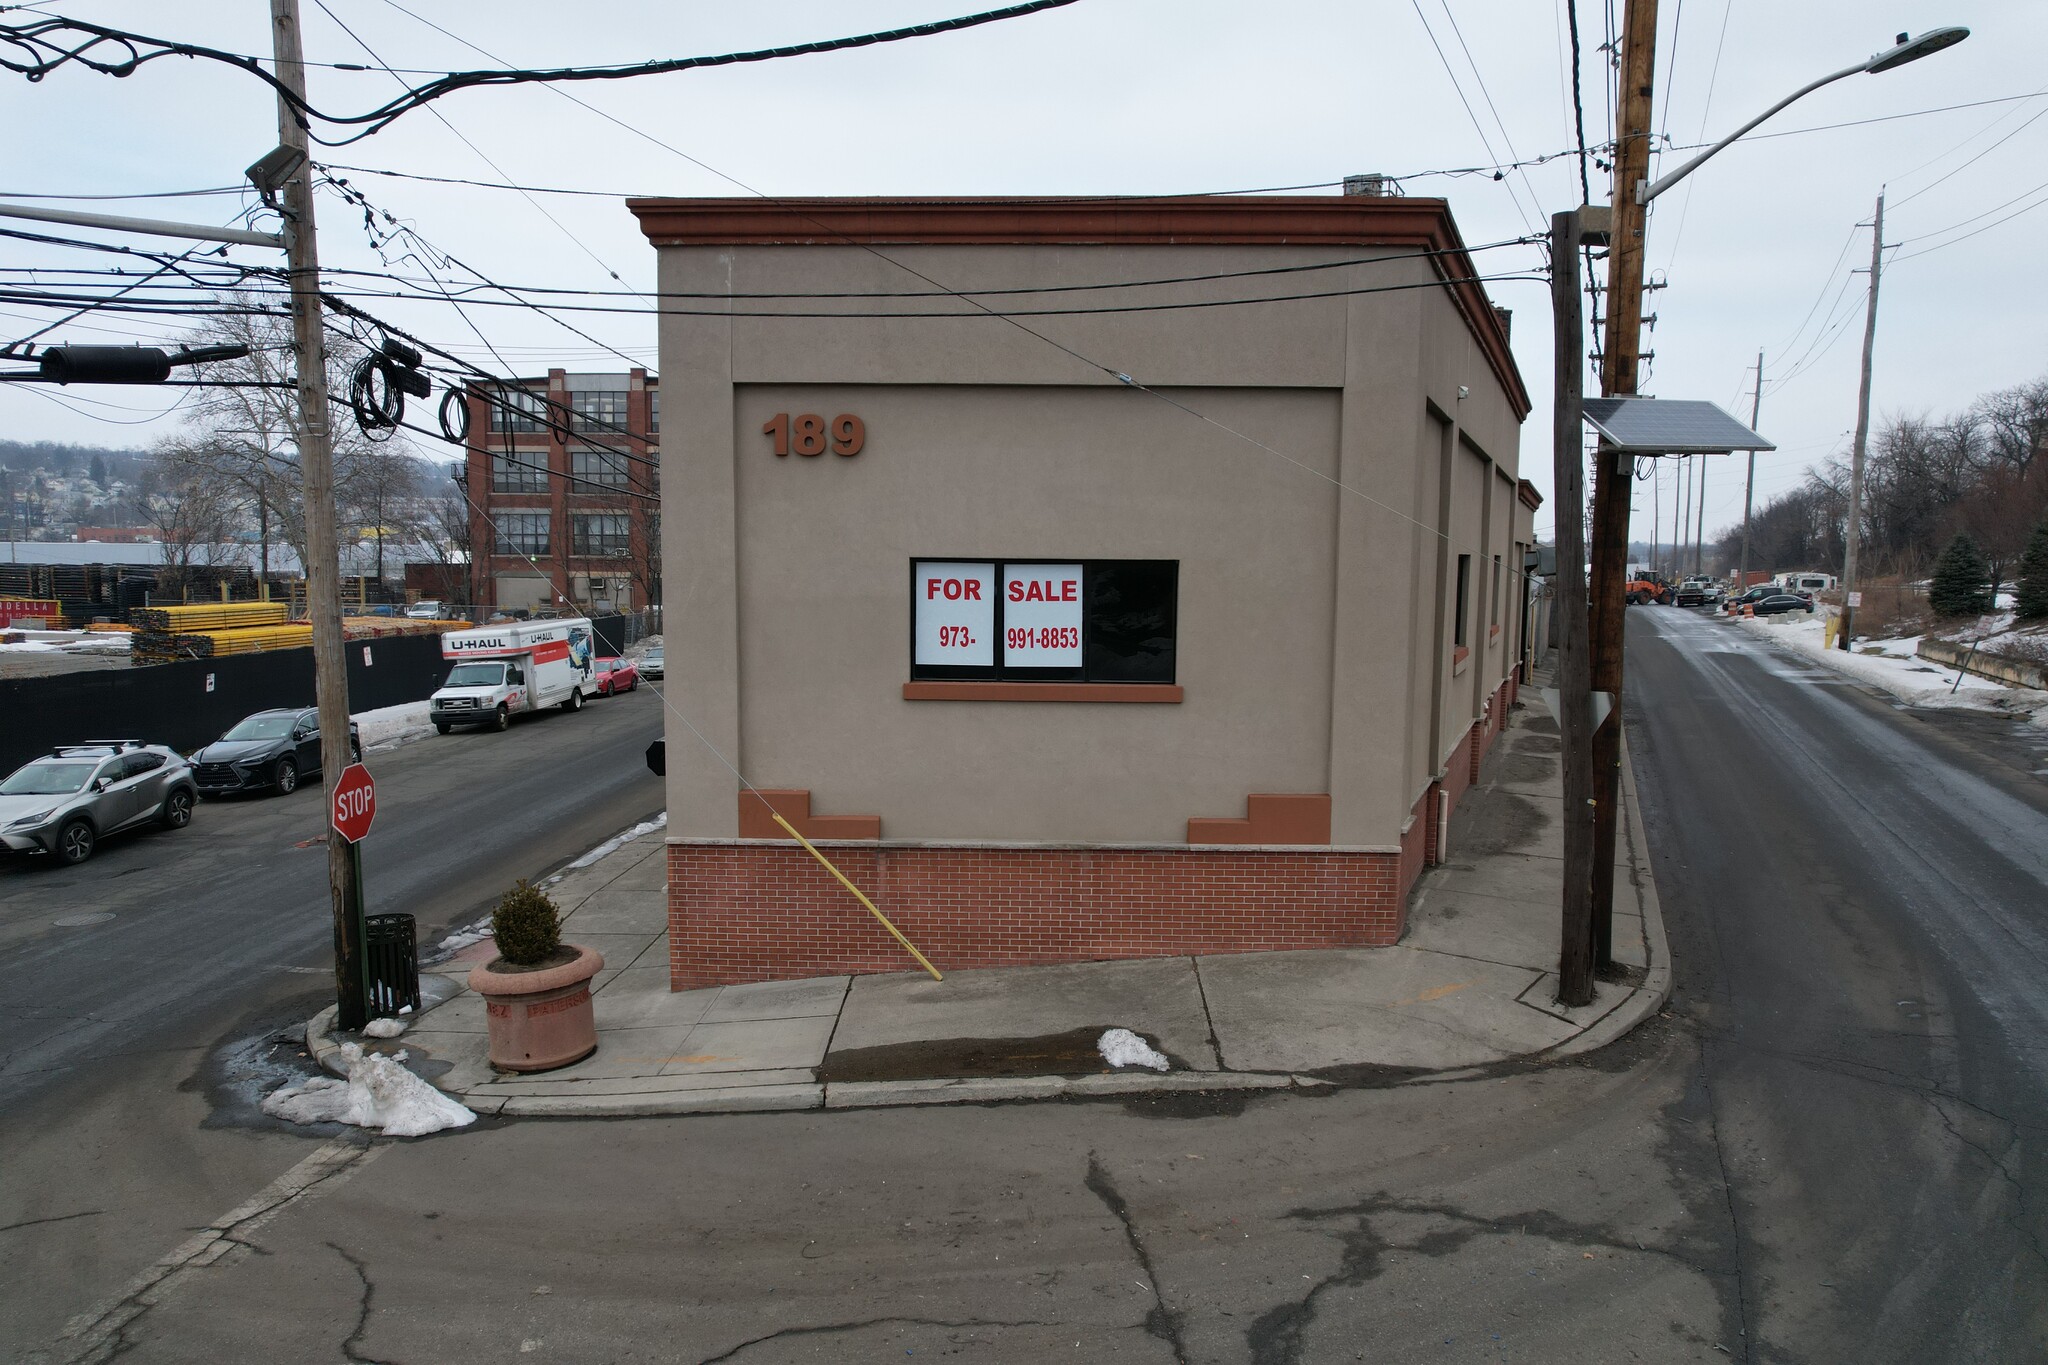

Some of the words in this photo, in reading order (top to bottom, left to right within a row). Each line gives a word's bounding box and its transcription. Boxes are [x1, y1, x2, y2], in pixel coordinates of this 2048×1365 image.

[763, 413, 865, 456] 189
[927, 578, 982, 601] FOR
[1008, 580, 1078, 602] SALE
[451, 638, 506, 650] U-HAUL
[939, 625, 976, 648] 973-
[1007, 627, 1079, 649] 991-8853
[337, 784, 373, 822] STOP
